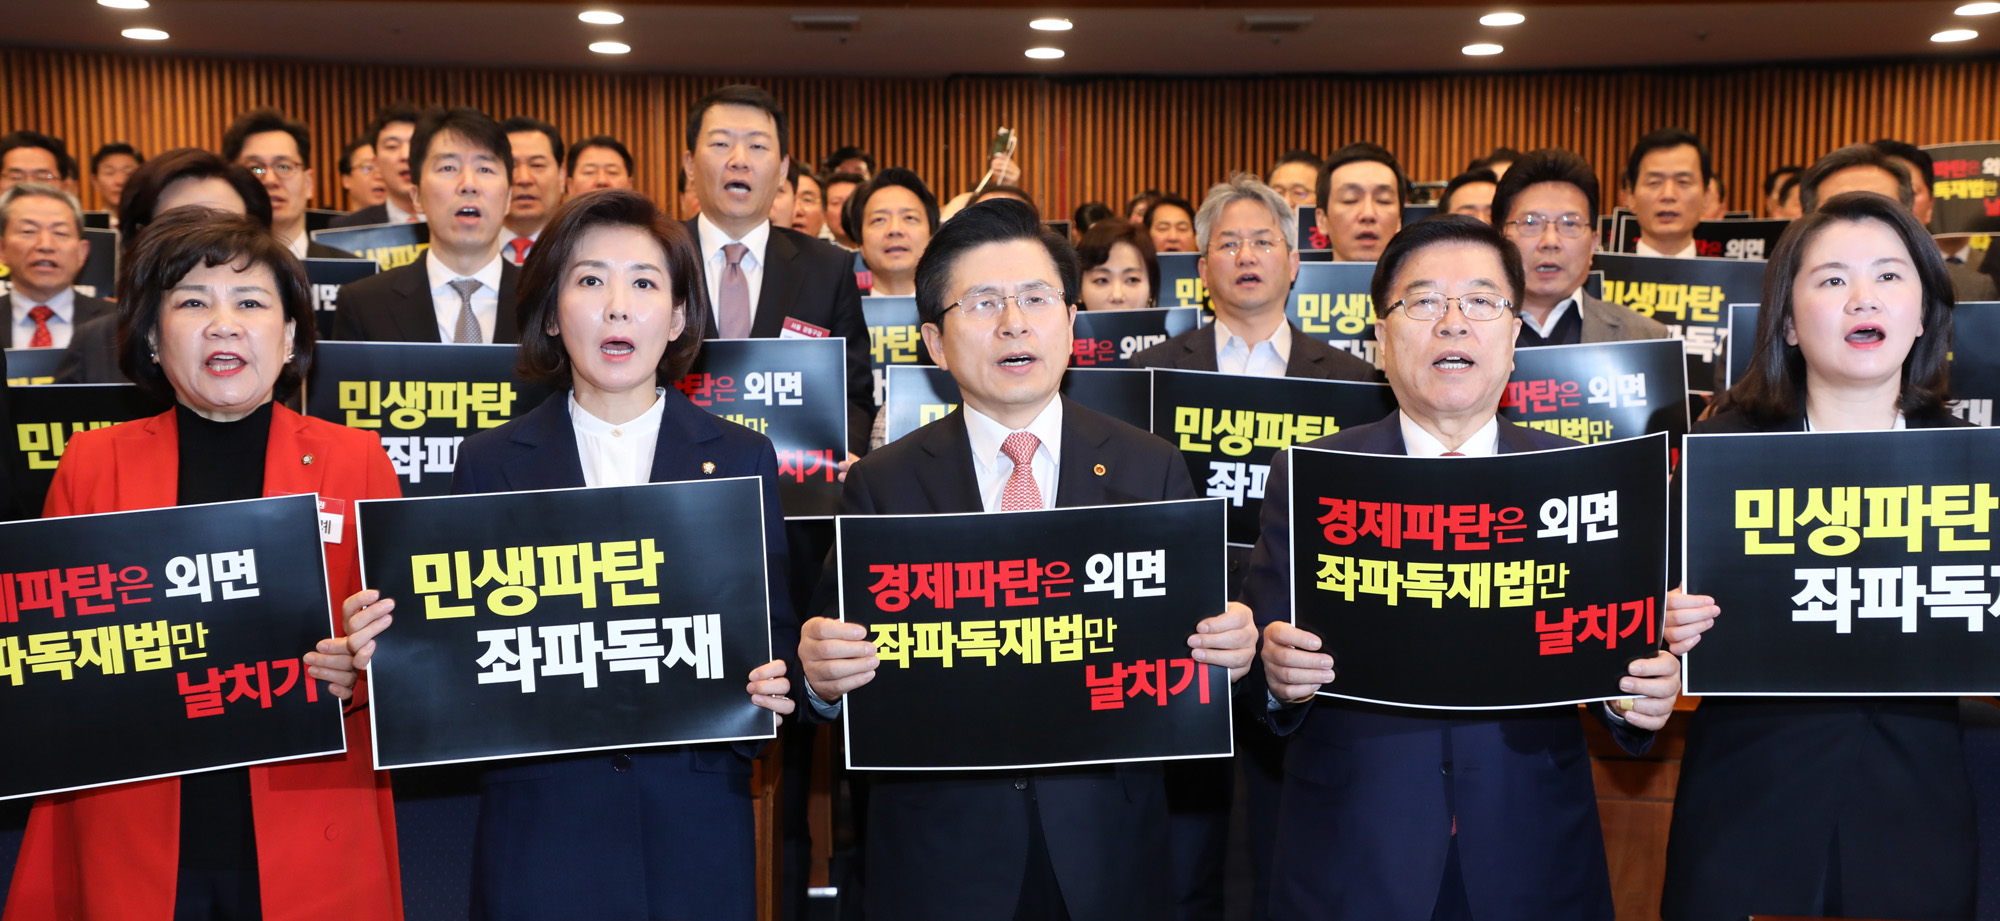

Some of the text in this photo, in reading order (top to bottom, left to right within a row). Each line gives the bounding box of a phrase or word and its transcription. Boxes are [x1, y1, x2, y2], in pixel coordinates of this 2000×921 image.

[339, 380, 517, 430] 민생파탄
[743, 371, 803, 406] 외면
[1587, 372, 1648, 409] 외면
[1316, 489, 1619, 551] 경제파탄은 외면
[1735, 483, 2000, 557] 민생파탄
[165, 548, 260, 603] 외면
[411, 538, 665, 620] 민생파탄
[867, 549, 1167, 613] 경제파탄은 외면
[1315, 553, 1571, 610] 좌파독재법만
[1791, 564, 2000, 634] 좌파독
[475, 613, 725, 694] 좌파독재
[869, 613, 1118, 669] 좌파독재법만
[1534, 596, 1656, 656] 날치기
[176, 657, 319, 719] 날치기
[1085, 657, 1211, 711] 날치기
